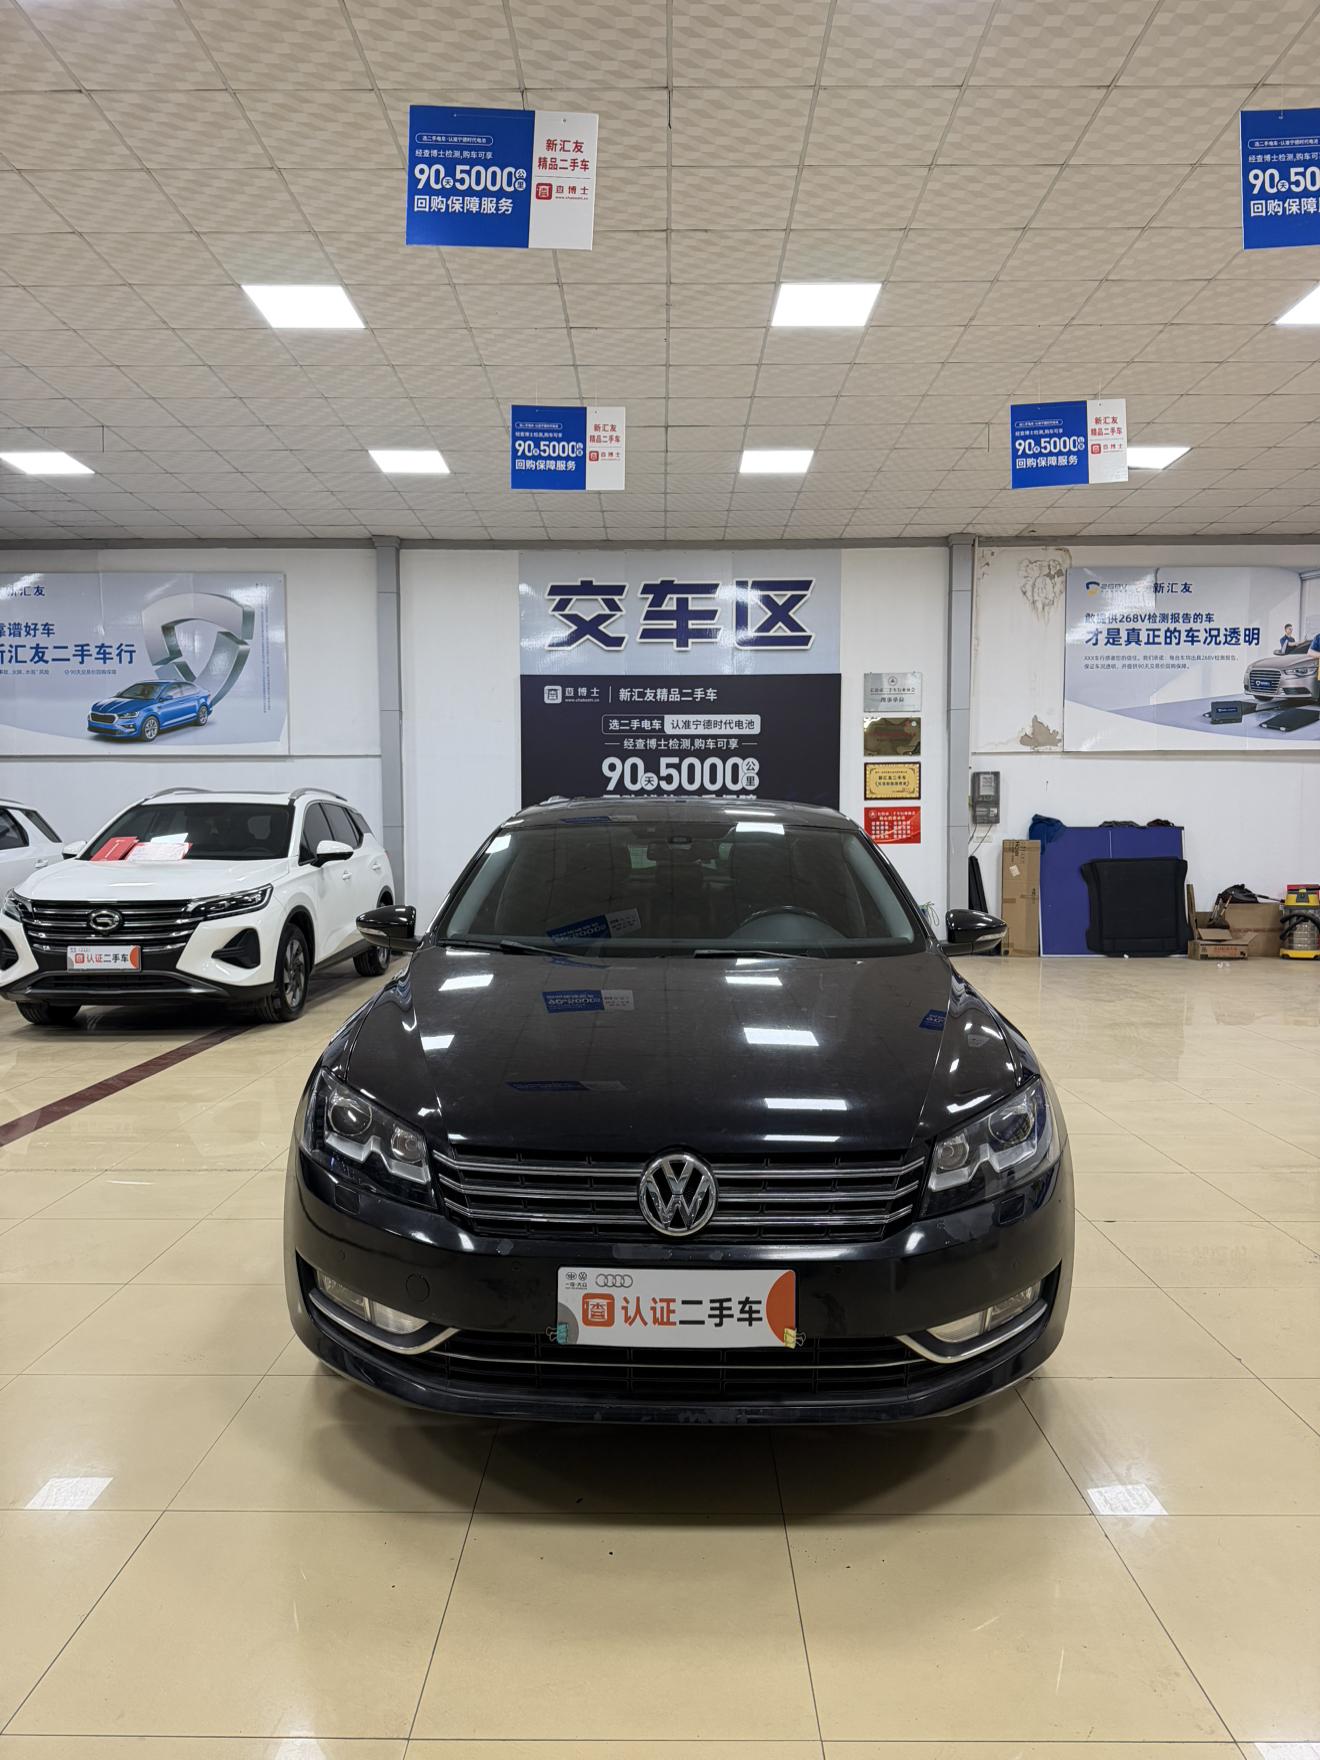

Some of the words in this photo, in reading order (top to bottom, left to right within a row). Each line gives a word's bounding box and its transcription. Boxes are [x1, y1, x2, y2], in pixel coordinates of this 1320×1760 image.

[545, 138, 585, 154] 新汇友
[537, 156, 590, 173] 精品二手车
[1248, 152, 1320, 163] 经查博士检测,购车可
[414, 195, 514, 215] 回购保障服务
[1250, 197, 1320, 217] 回购保障
[1153, 582, 1193, 594] 新汇友
[545, 576, 816, 651] 交车区
[1084, 627, 1261, 647] 才是真正的车况透明
[0, 643, 137, 665] 汇友二手车行
[619, 687, 718, 702] 新汇友精品二手车
[608, 718, 663, 731] 选二手电车
[671, 718, 755, 731] 认准宁德时代电池
[623, 738, 739, 751] 经查博士检测,购车可享
[86, 953, 129, 963] 认证二手车
[621, 1295, 763, 1327] 认证二手车
